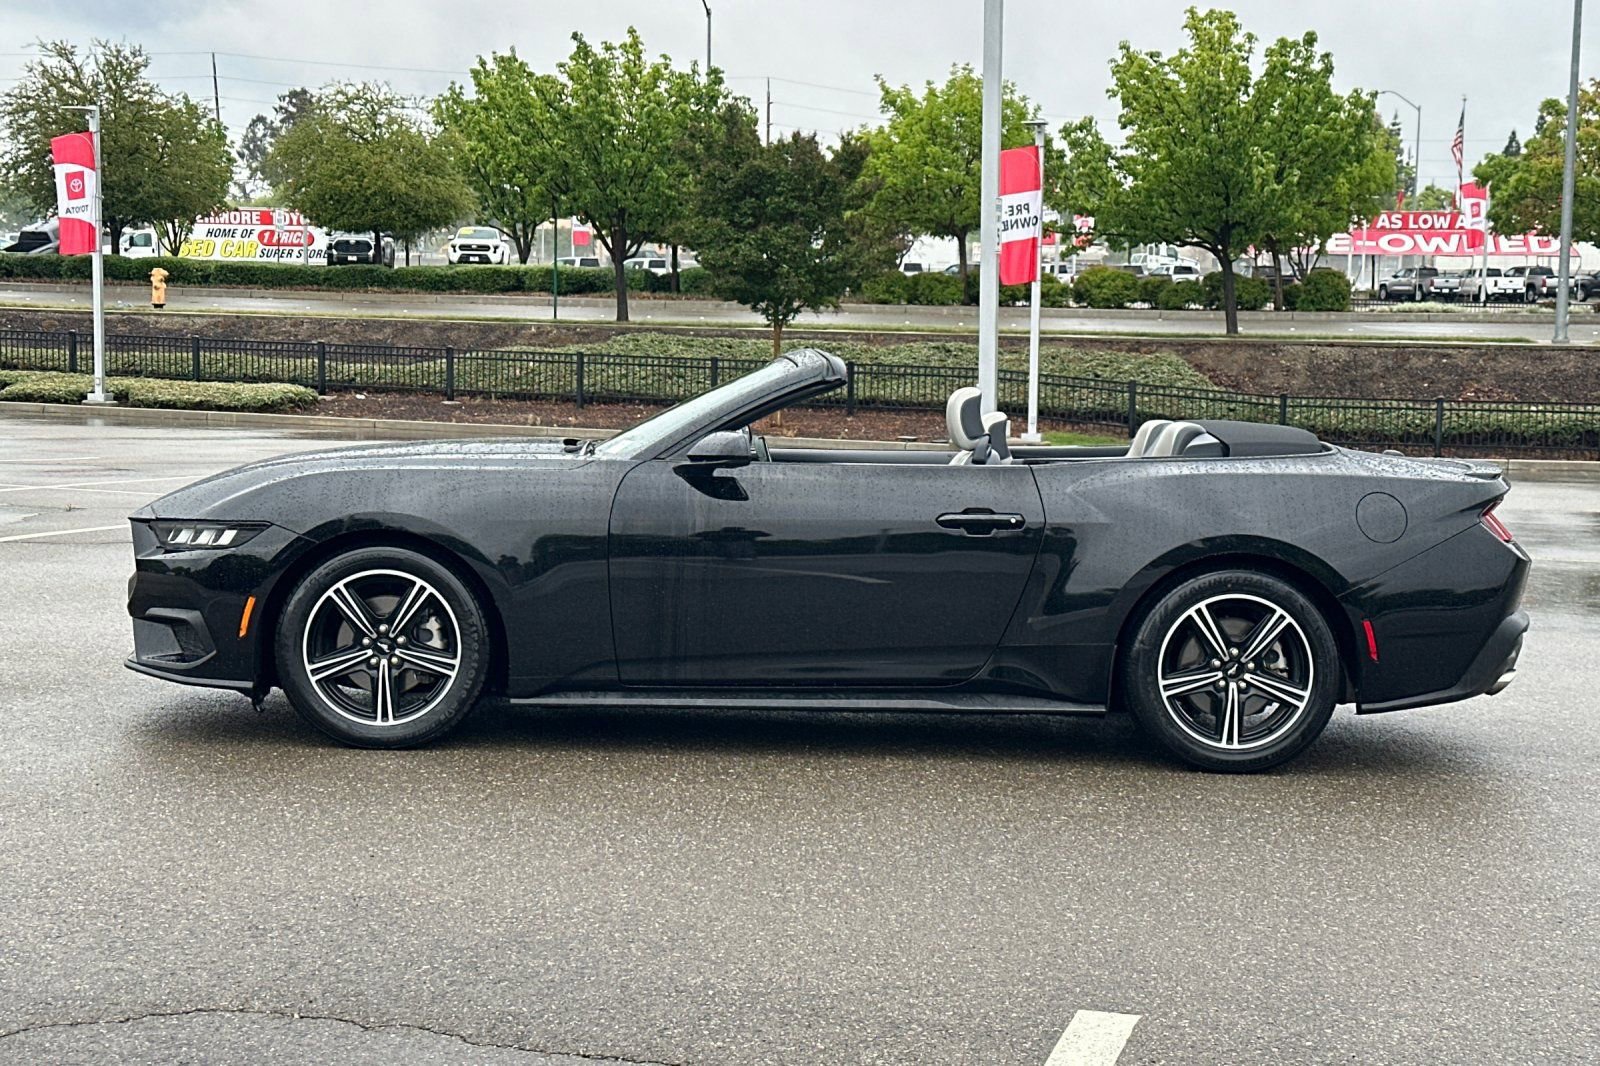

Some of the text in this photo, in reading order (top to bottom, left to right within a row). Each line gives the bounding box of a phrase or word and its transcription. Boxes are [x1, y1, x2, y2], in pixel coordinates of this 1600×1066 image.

[1376, 213, 1402, 229] AS
[1409, 213, 1451, 229] LOW
[1455, 214, 1469, 229] A
[206, 228, 238, 238] HOME
[241, 229, 255, 239] OF
[263, 231, 270, 243] 1
[179, 240, 328, 259] SED CAR SUPER SORE
